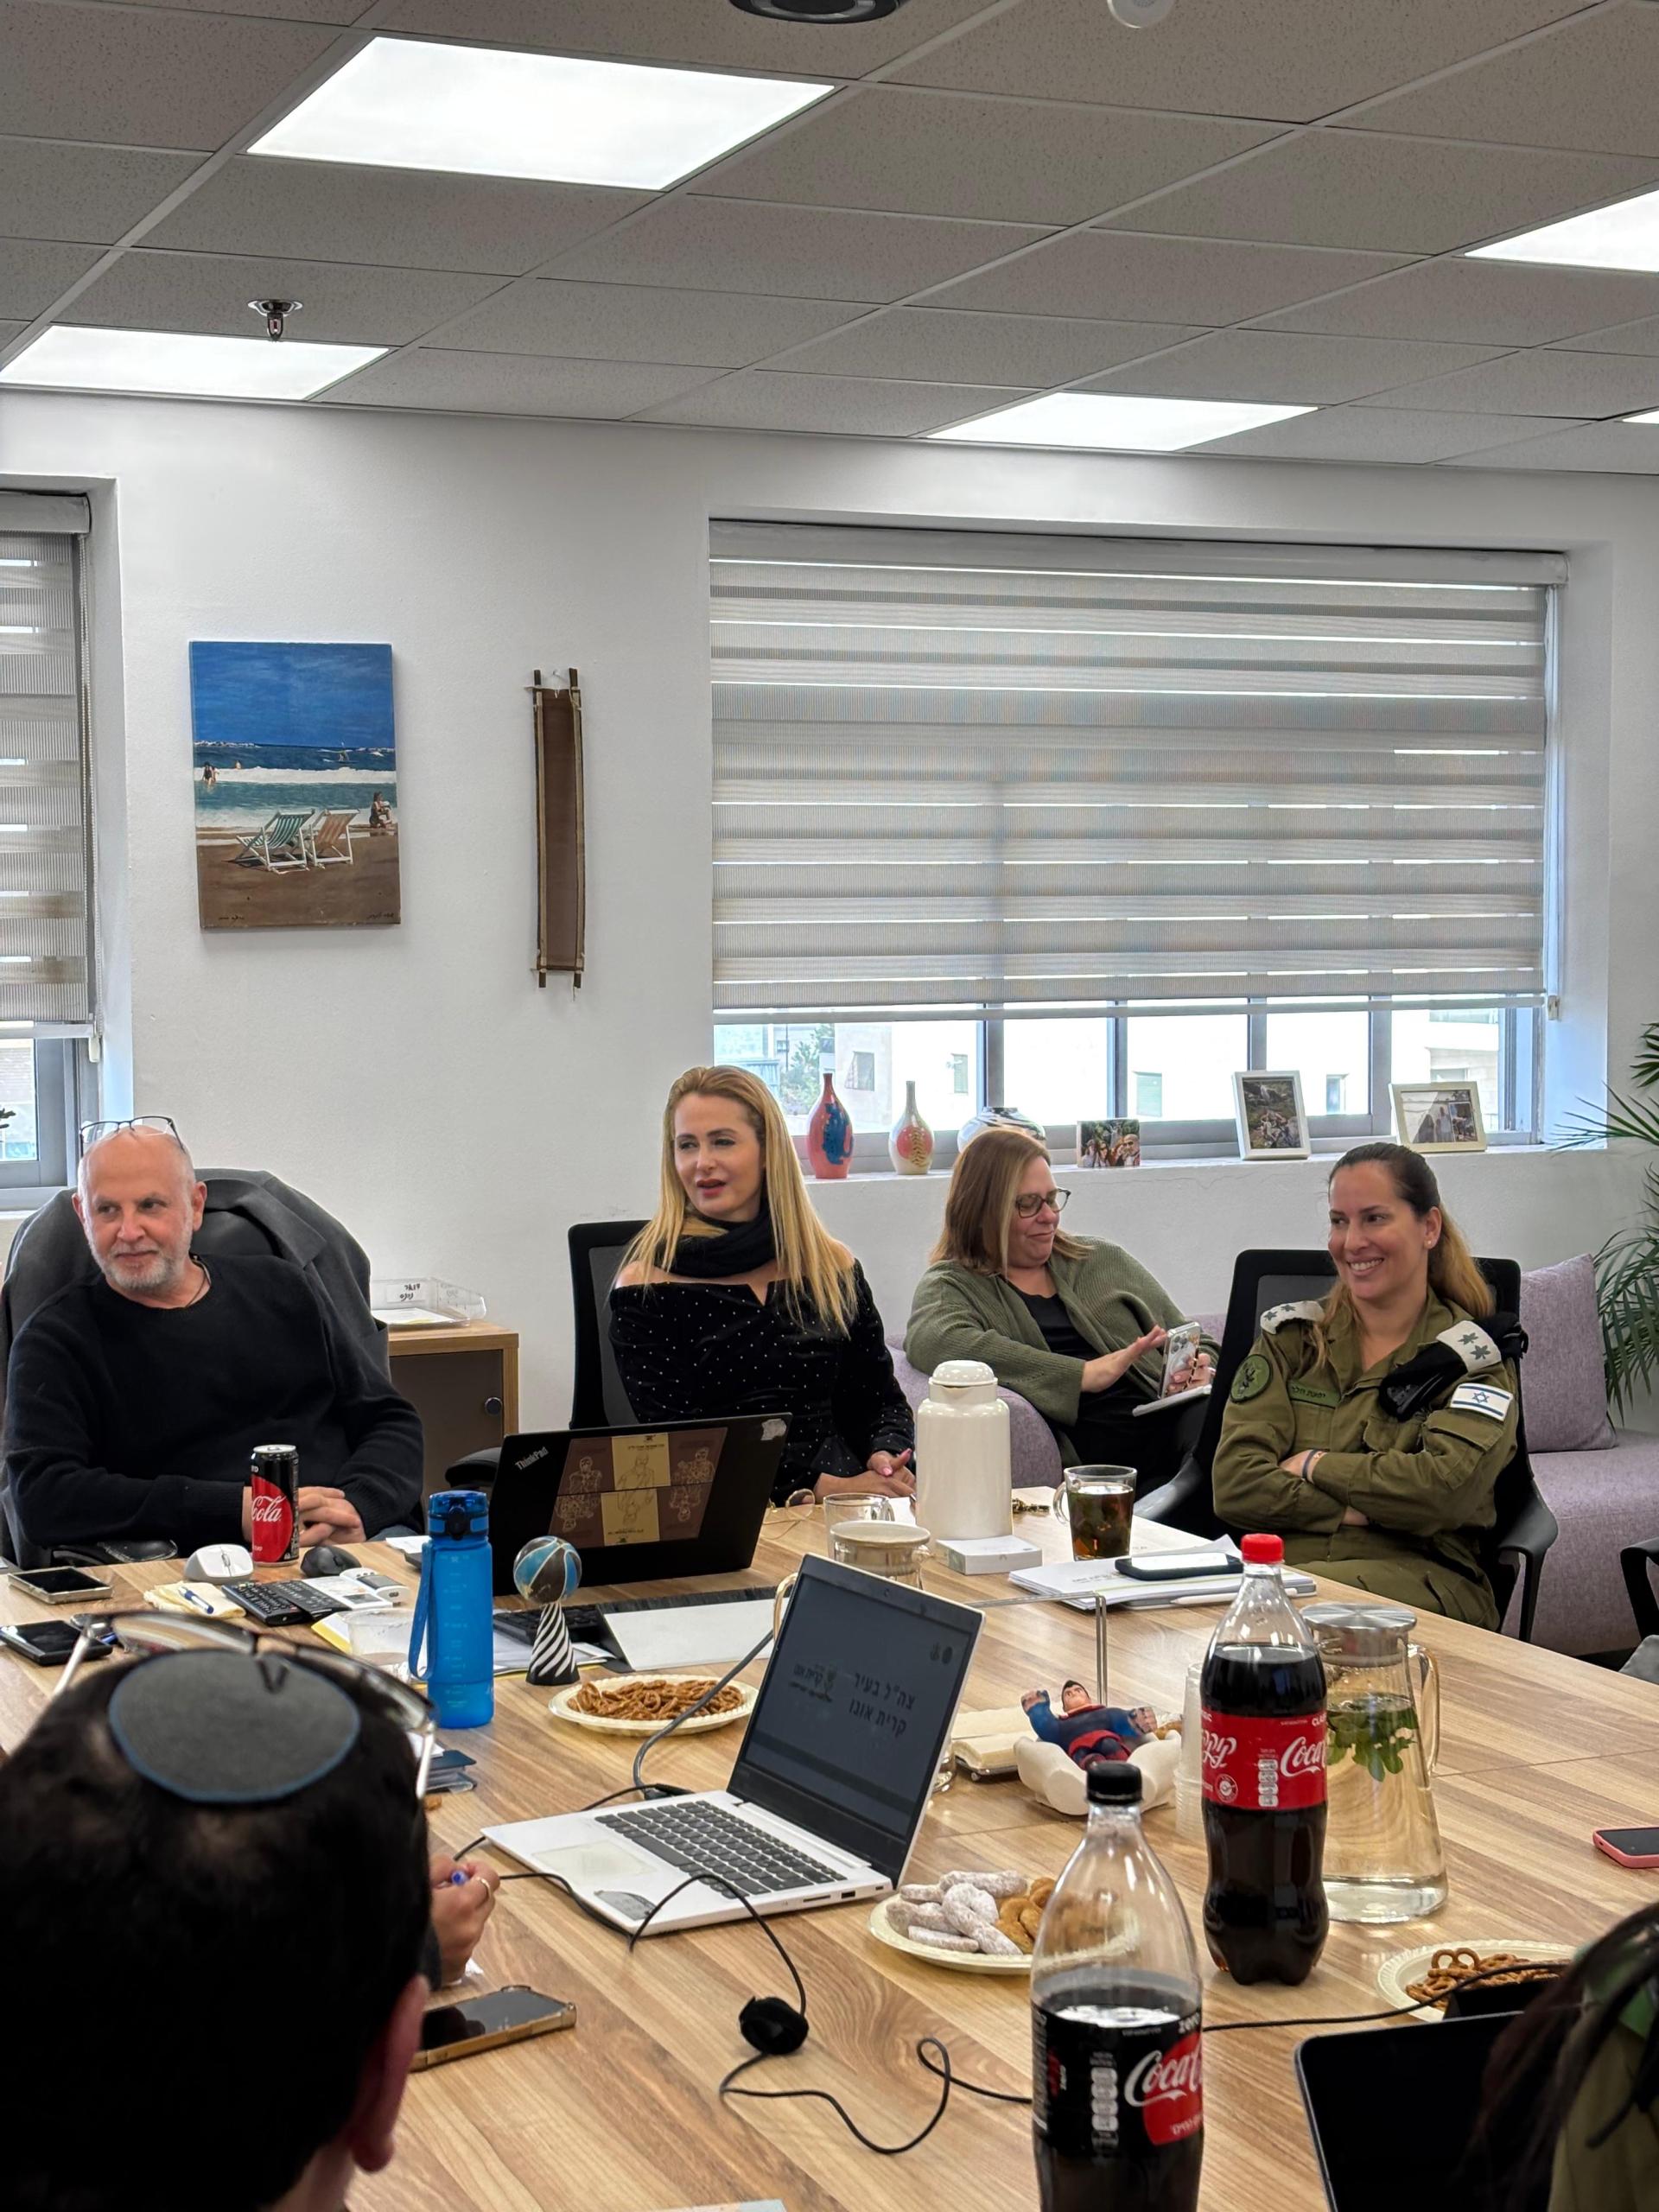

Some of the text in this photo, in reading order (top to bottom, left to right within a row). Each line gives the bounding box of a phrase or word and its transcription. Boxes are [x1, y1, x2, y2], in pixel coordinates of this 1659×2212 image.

[515, 1446, 549, 1470] ThinkPad
[855, 1672, 880, 1697] בעיר
[849, 1698, 907, 1738] קרית אונו
[1281, 1736, 1326, 1777] Coca
